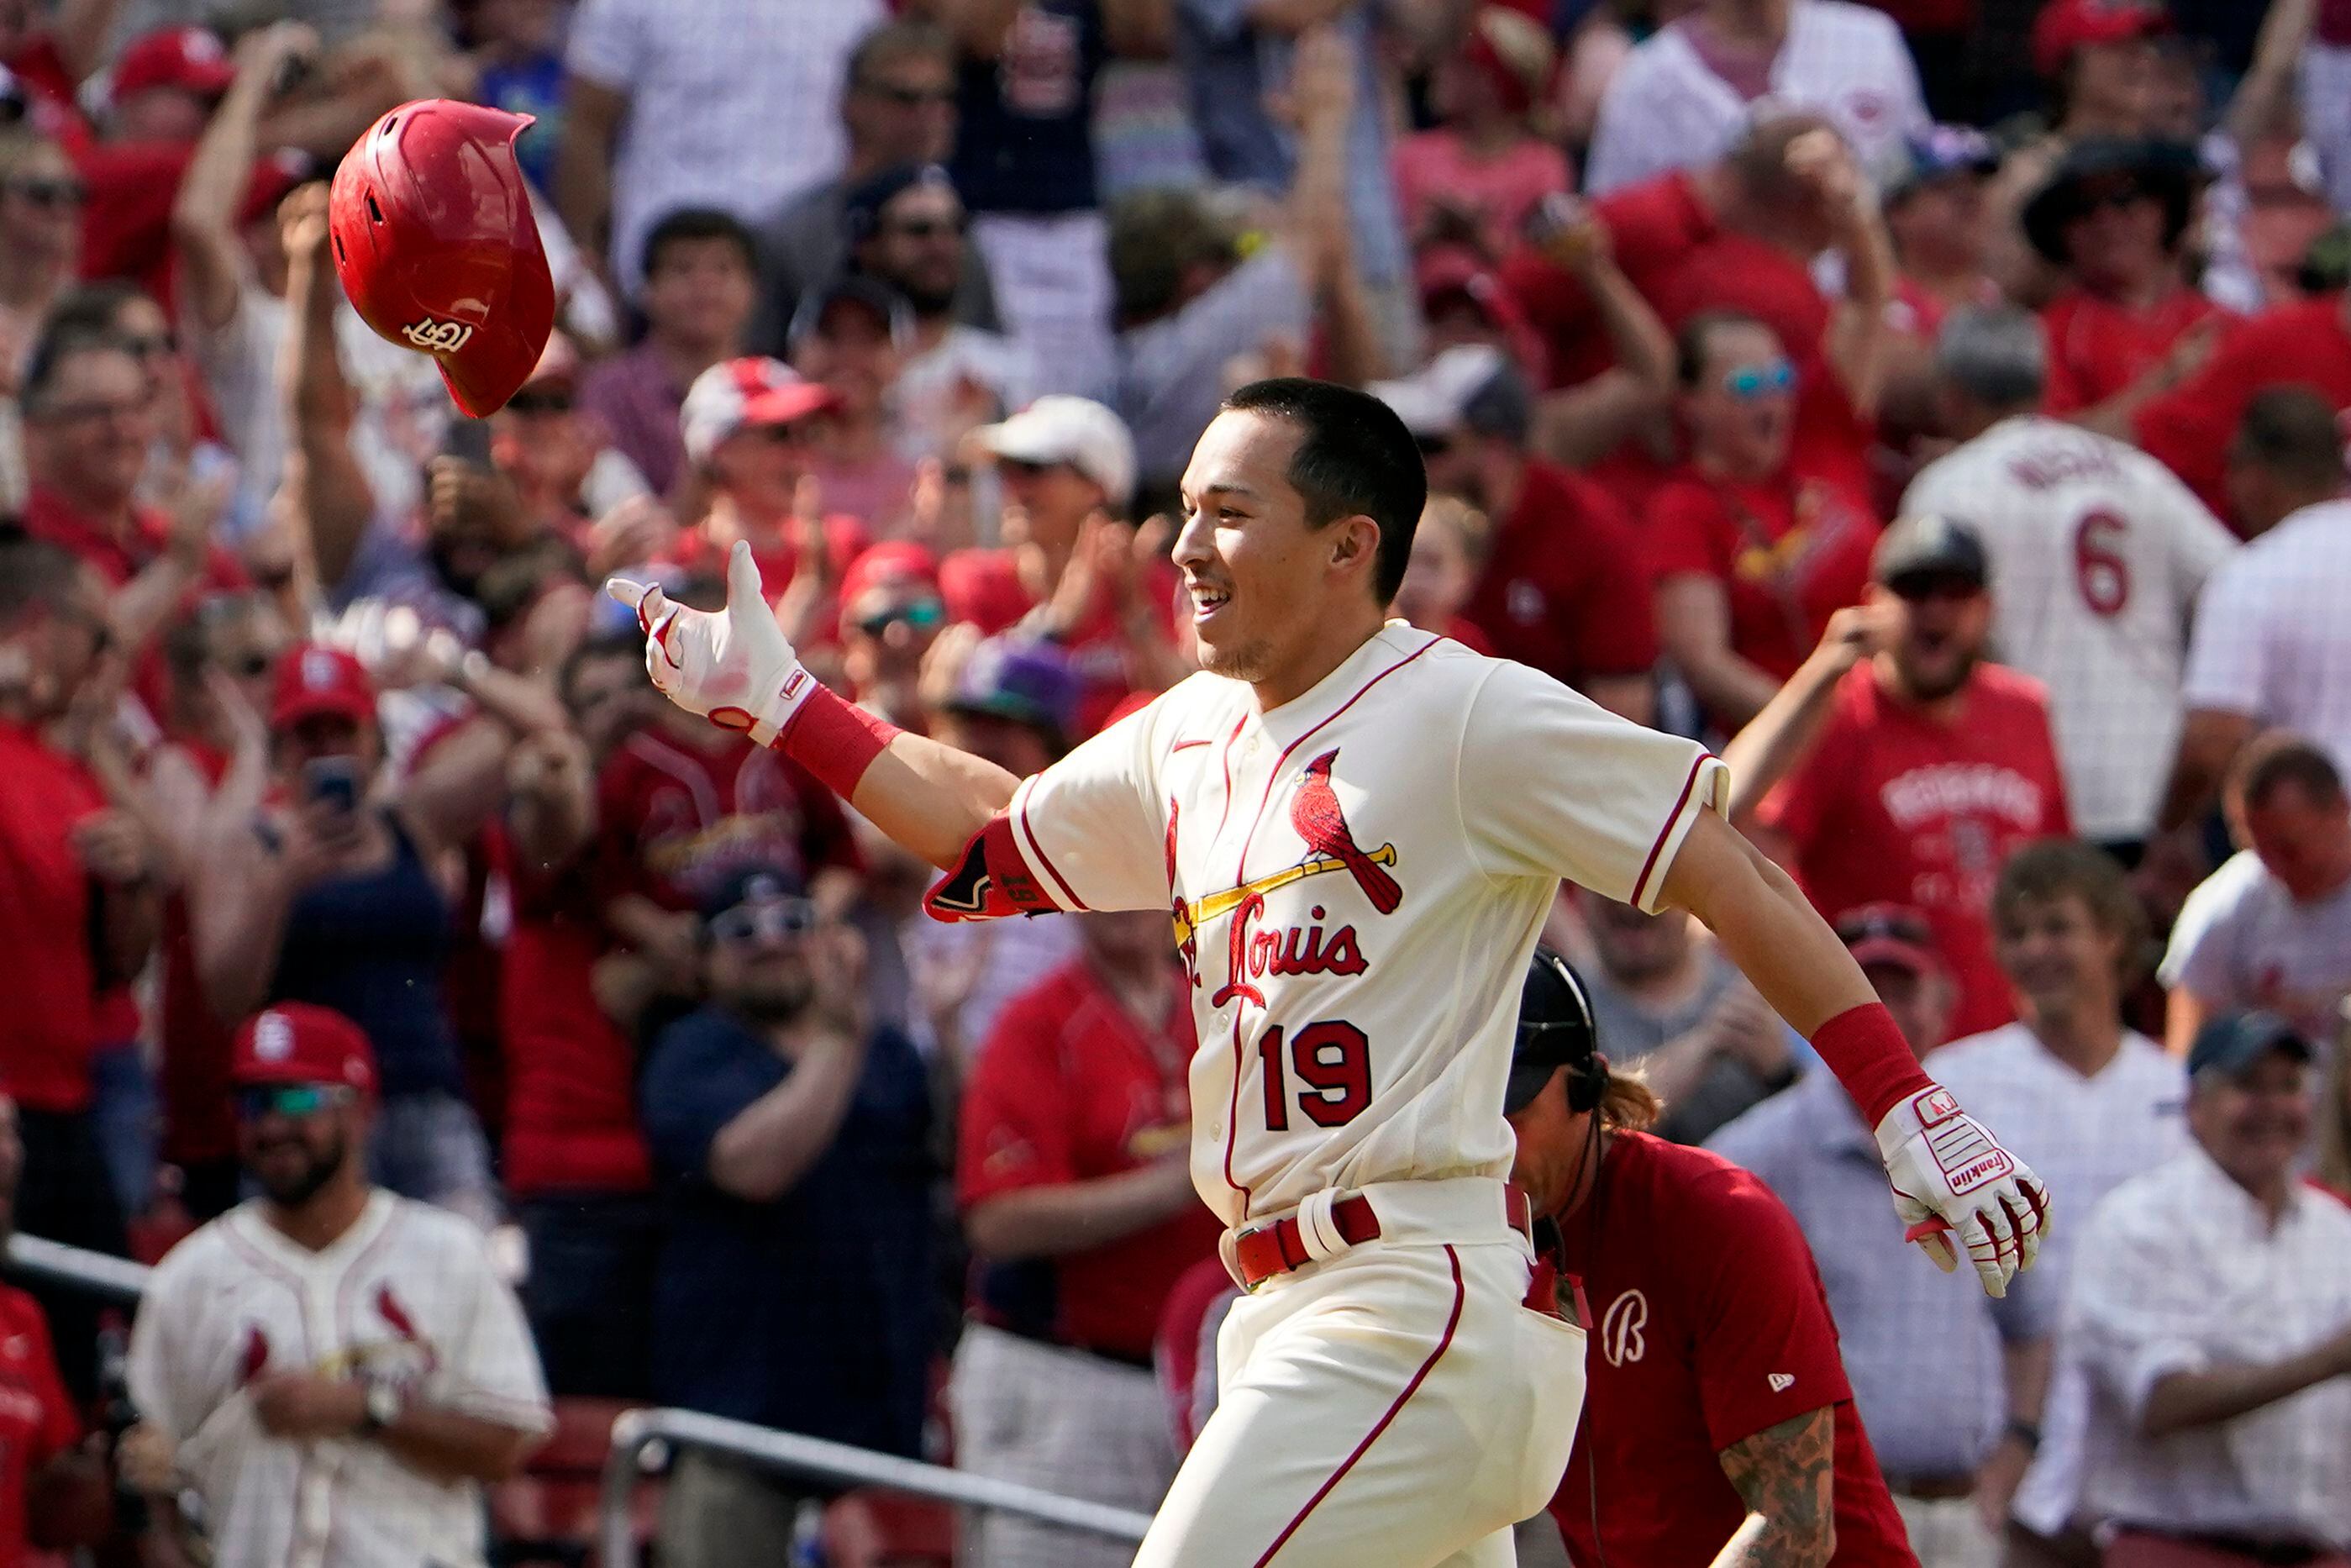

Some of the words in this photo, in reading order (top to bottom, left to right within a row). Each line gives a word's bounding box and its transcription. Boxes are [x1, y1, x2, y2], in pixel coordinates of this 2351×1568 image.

[2075, 508, 2127, 618] 6
[1212, 892, 1370, 1010] Louis
[1259, 1019, 1372, 1131] 19
